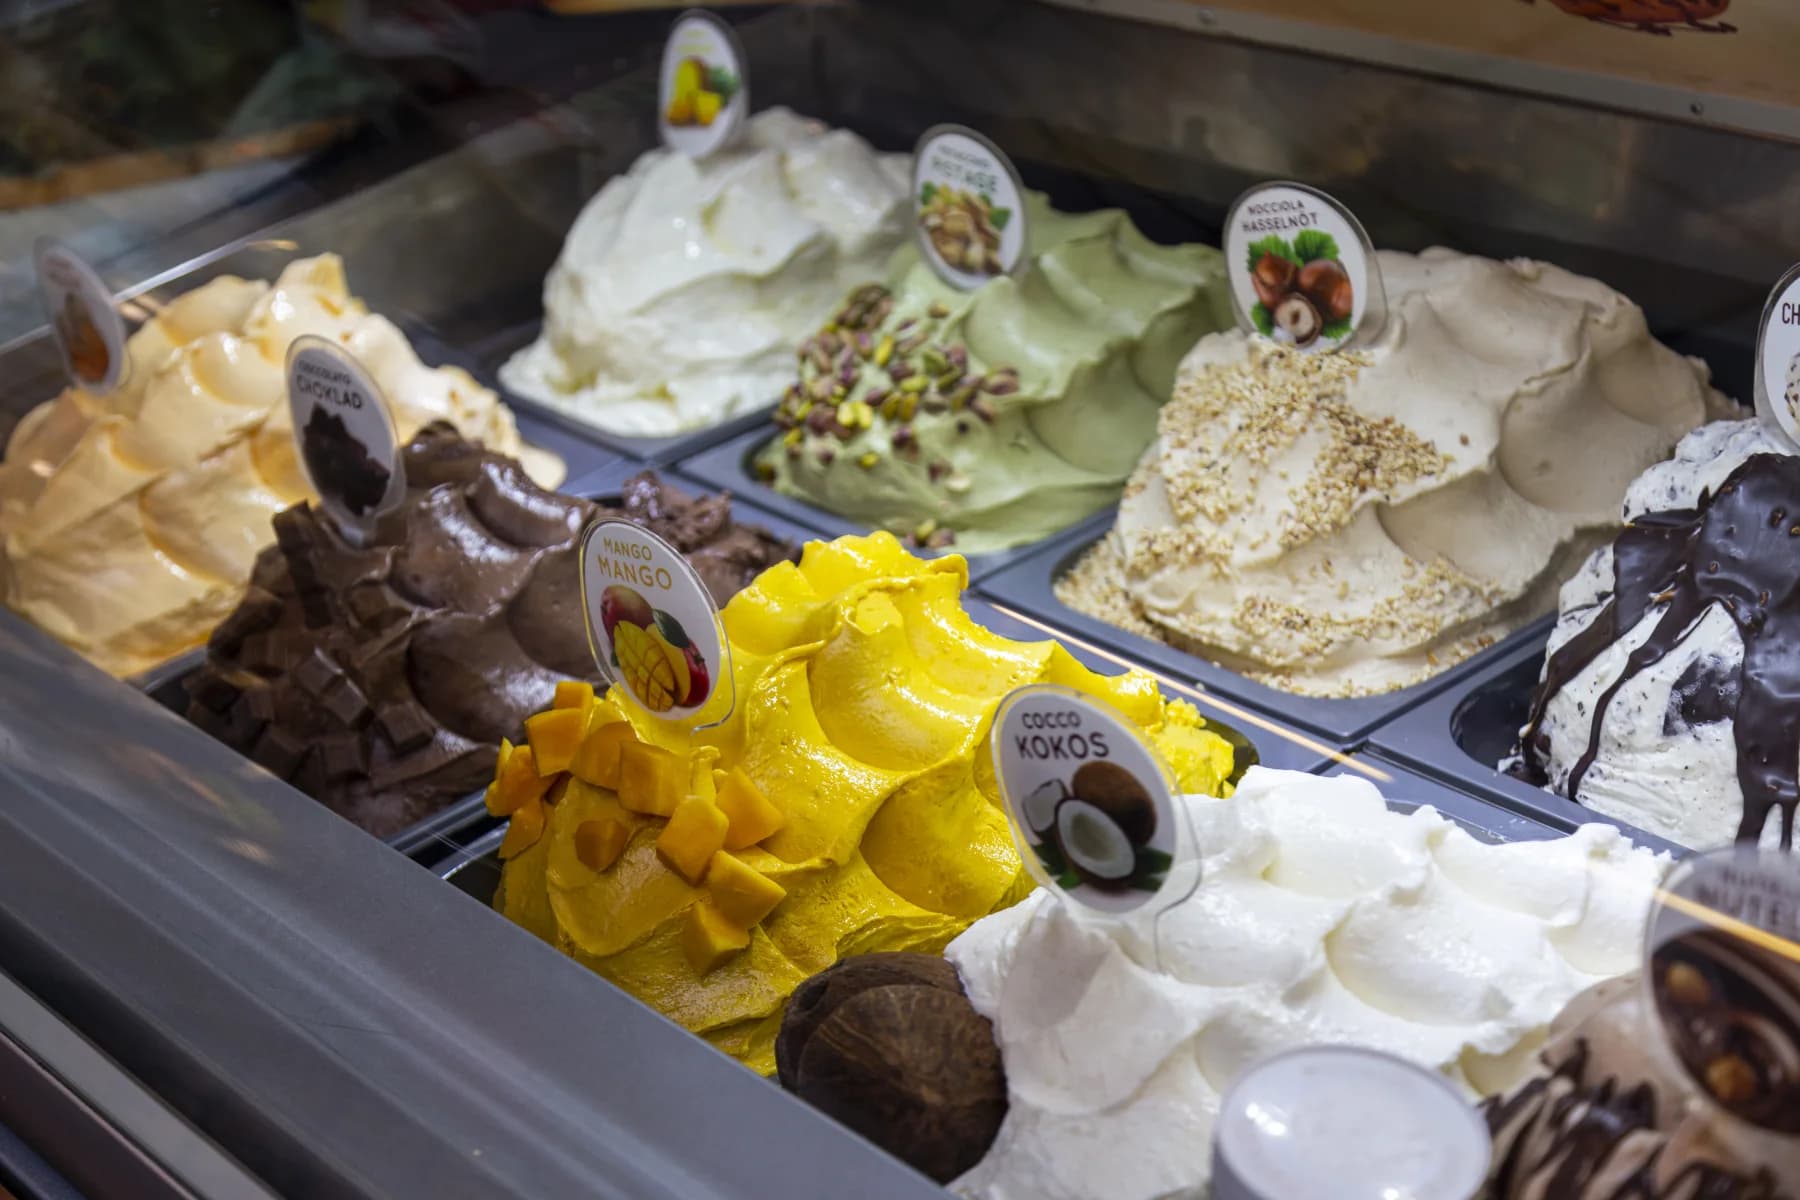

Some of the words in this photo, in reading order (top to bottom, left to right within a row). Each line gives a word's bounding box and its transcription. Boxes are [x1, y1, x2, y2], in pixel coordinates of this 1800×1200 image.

[296, 374, 363, 410] CHOKLAD
[603, 535, 653, 561] MANGO
[597, 554, 673, 591] MANGO
[1022, 711, 1082, 730] COCCO
[1014, 732, 1110, 760] KOKOS
